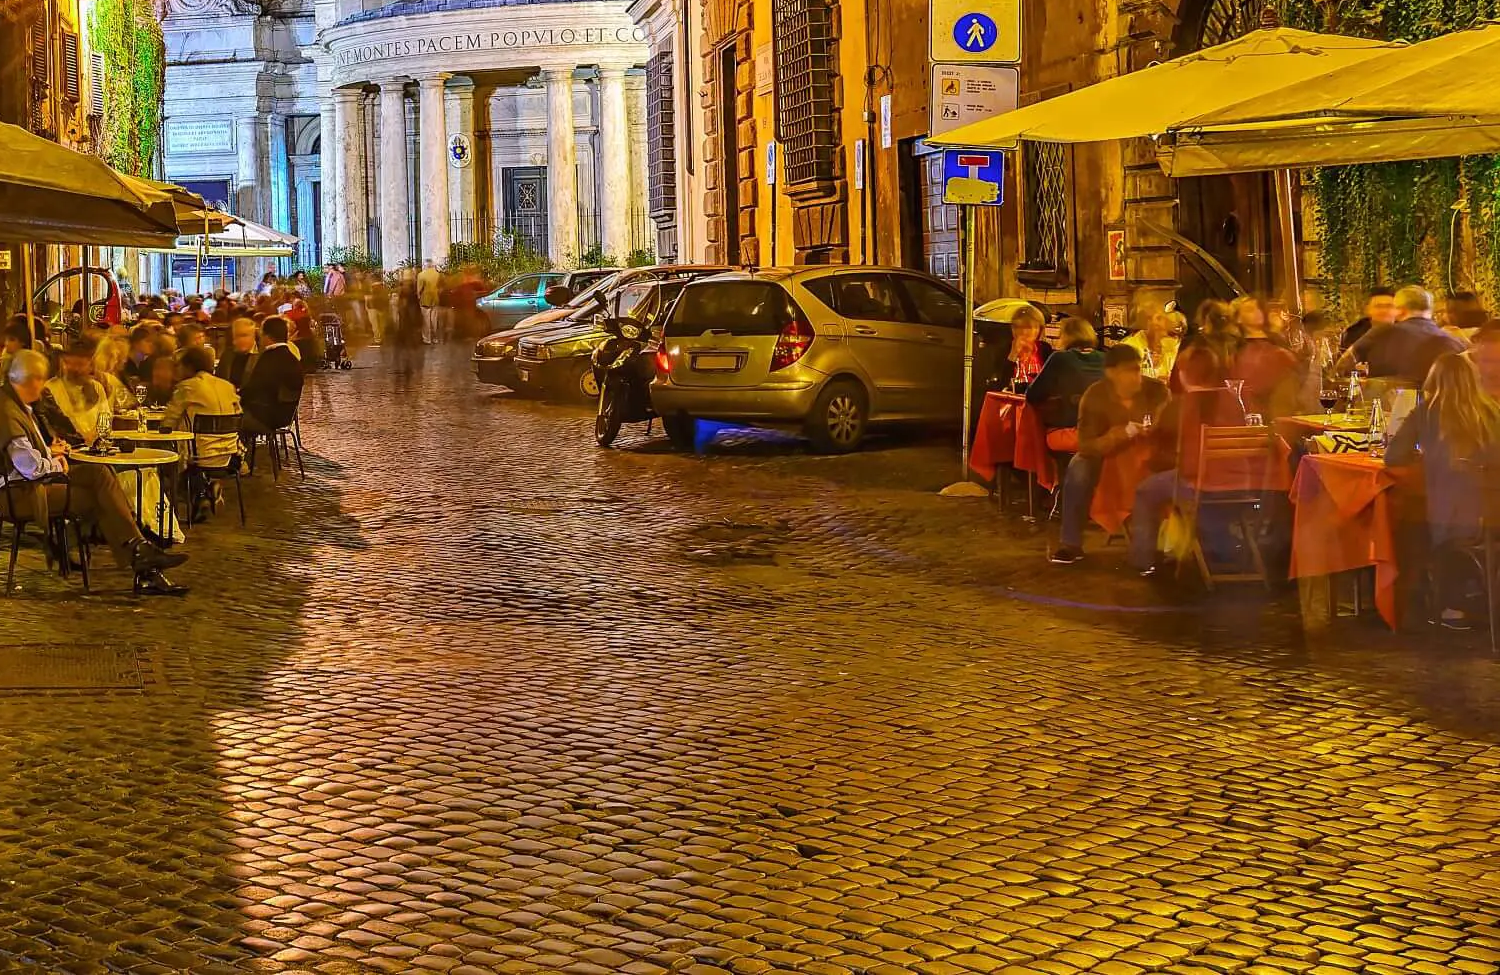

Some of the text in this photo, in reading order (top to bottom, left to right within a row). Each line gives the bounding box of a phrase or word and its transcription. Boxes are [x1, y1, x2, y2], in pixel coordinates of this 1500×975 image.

[351, 40, 410, 63] MONTES
[417, 34, 482, 53] PACEM
[585, 27, 607, 43] ET
